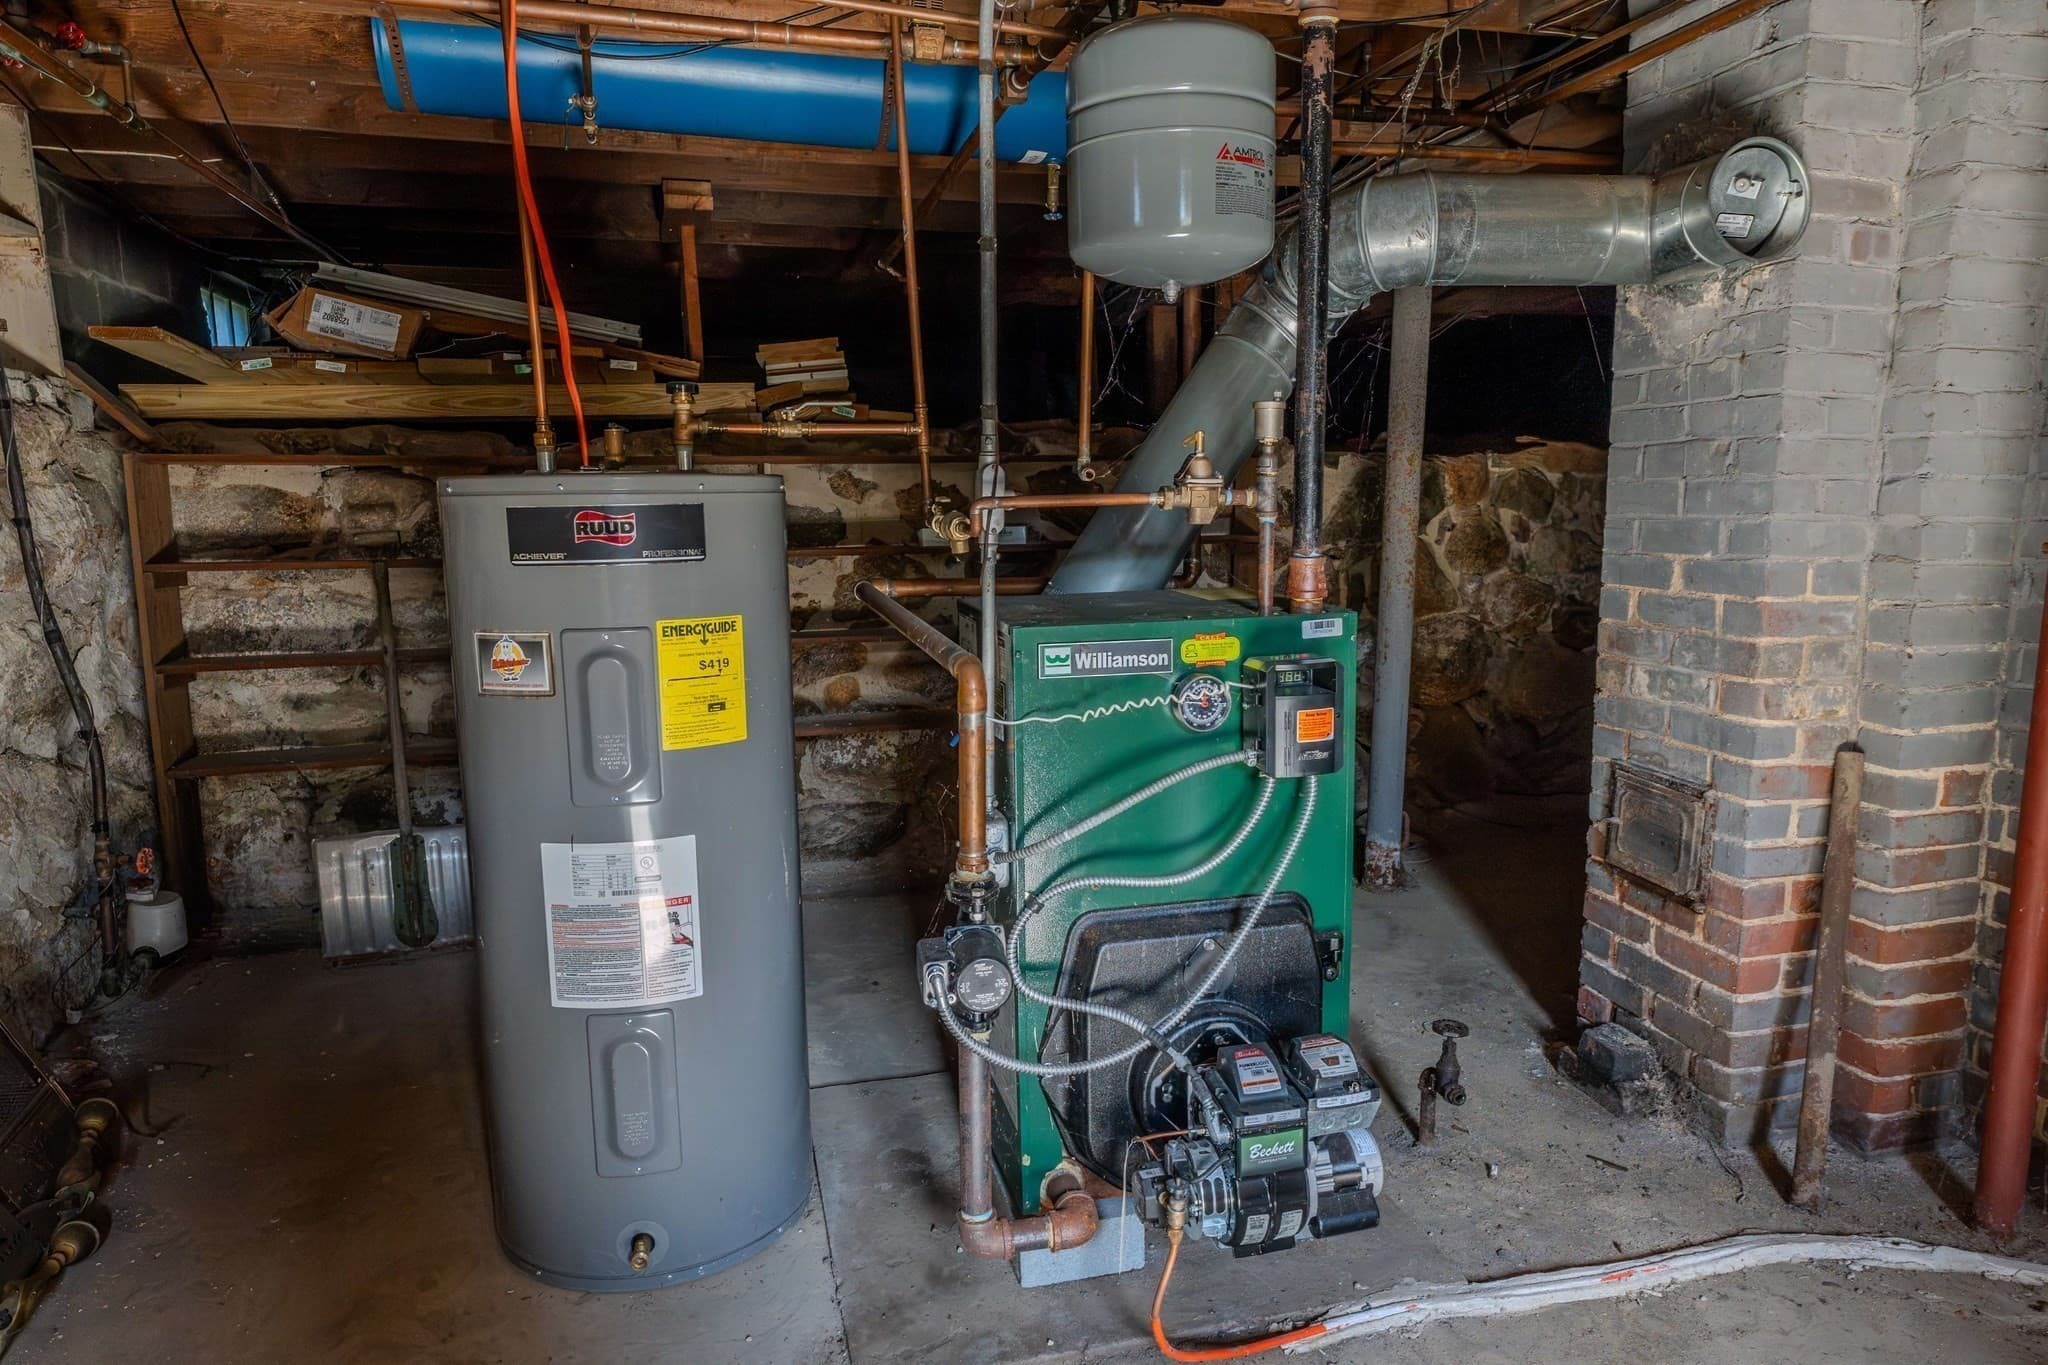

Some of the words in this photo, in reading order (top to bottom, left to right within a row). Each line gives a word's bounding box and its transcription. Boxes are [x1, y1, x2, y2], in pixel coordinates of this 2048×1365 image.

[1234, 147, 1263, 160] AMTROL
[575, 521, 634, 536] RUUD
[513, 552, 566, 560] ACHIEVER
[662, 620, 737, 639] ENERGYGUIDE
[699, 658, 730, 671] $419
[1074, 650, 1169, 669] Williamson
[1249, 1140, 1295, 1159] Beckett
